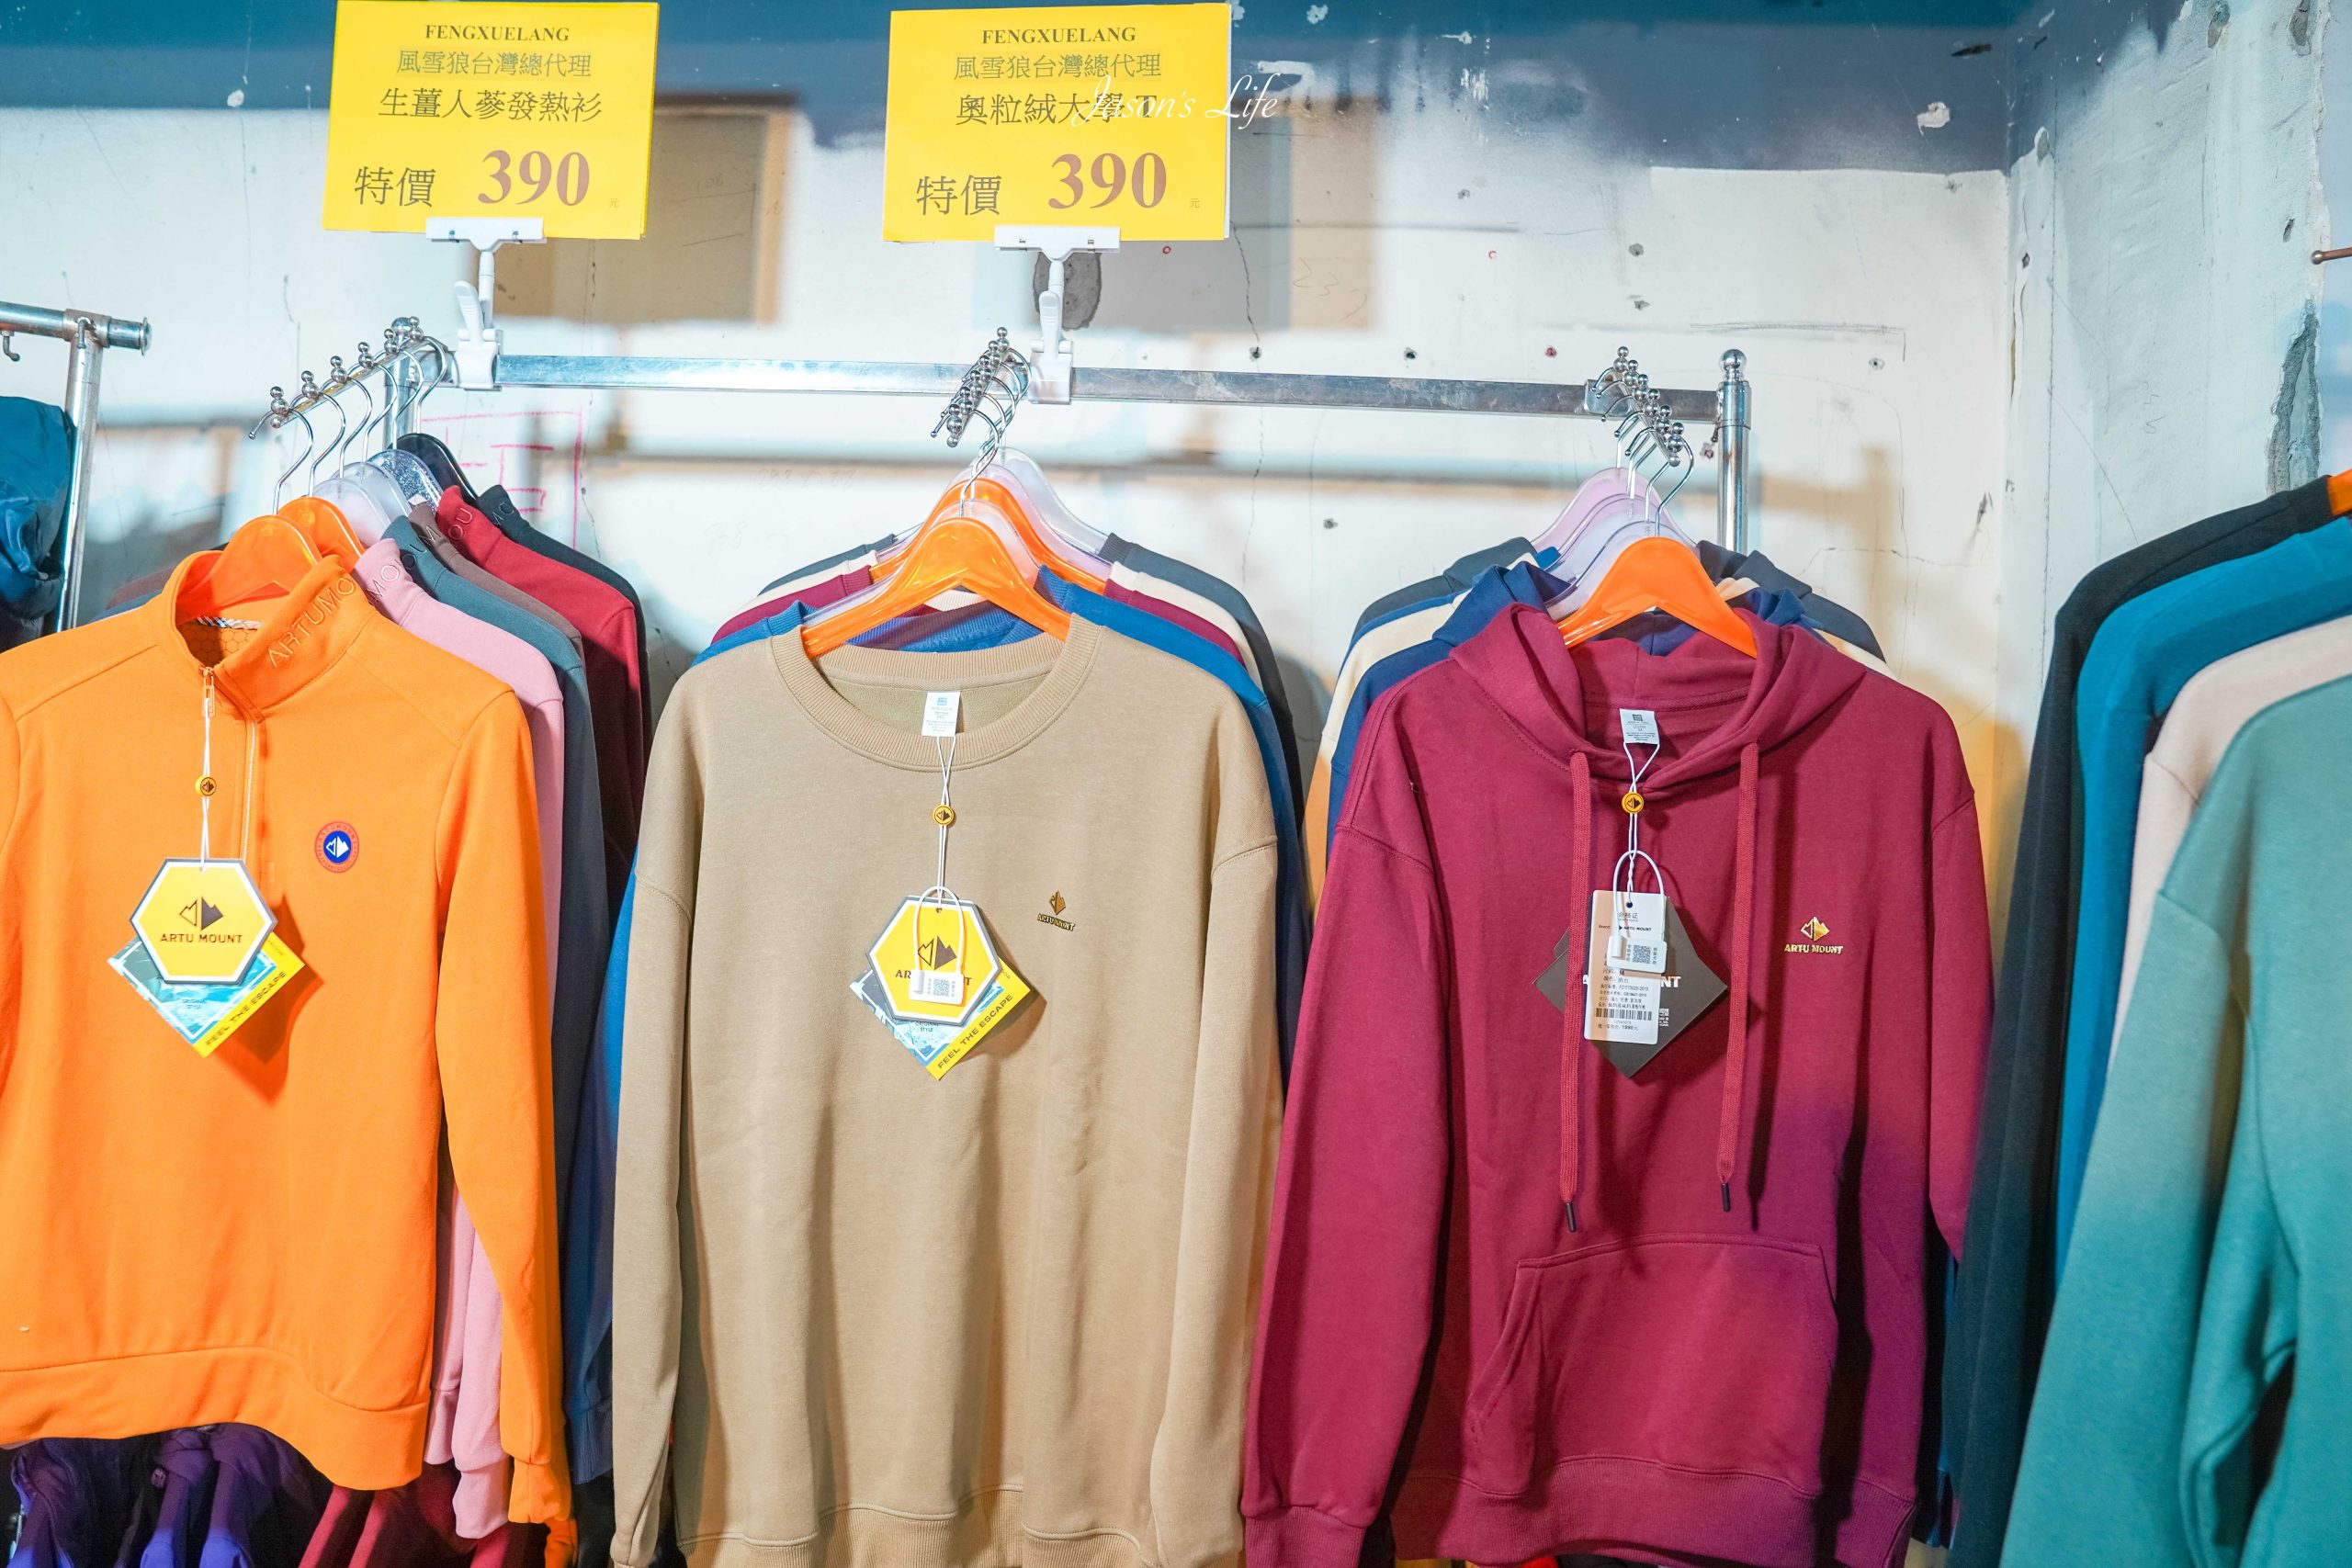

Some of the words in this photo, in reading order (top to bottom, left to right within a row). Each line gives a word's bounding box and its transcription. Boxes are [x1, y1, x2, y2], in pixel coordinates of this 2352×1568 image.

[425, 24, 570, 42] FENGXUELANG
[981, 27, 1136, 44] FENGXUELANG
[397, 50, 593, 77] 風雪狼台灣總代理
[954, 52, 1162, 80] 風雪狼台灣總代理
[378, 87, 603, 123] 生薑人蔘發熱衫
[354, 165, 436, 209] 特價
[478, 149, 590, 207] 390
[915, 175, 1002, 217] 特價
[1047, 152, 1167, 209] 390
[160, 933, 194, 943] ARTU
[198, 933, 243, 944] MOUNT
[1783, 944, 1810, 953] ARTU
[1811, 944, 1844, 954] MOUNT
[895, 969, 911, 980] AR
[937, 1047, 960, 1070] FEEL
[959, 1027, 980, 1046] THE
[978, 993, 1013, 1029] ESCAPE
